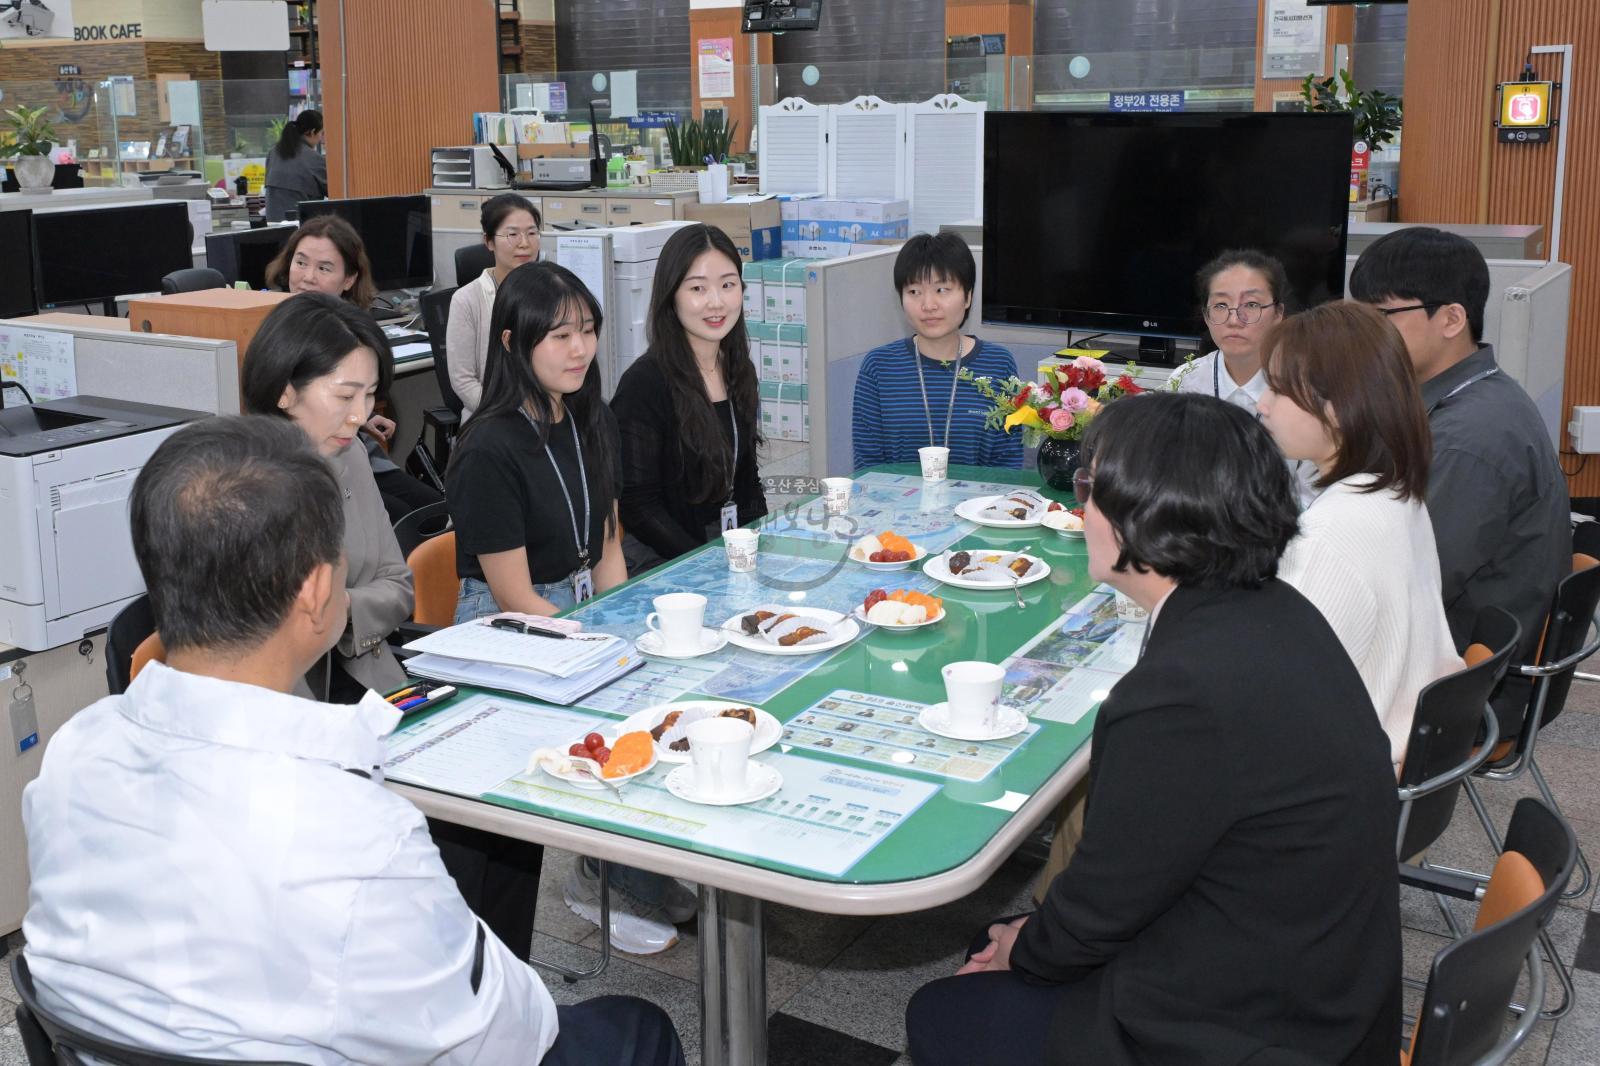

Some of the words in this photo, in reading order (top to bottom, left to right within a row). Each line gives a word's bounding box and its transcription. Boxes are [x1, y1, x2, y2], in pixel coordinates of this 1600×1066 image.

[74, 25, 107, 41] BOOK
[109, 23, 142, 39] CAFE
[1114, 95, 1146, 107] 정부24
[1149, 94, 1180, 107] 전용존
